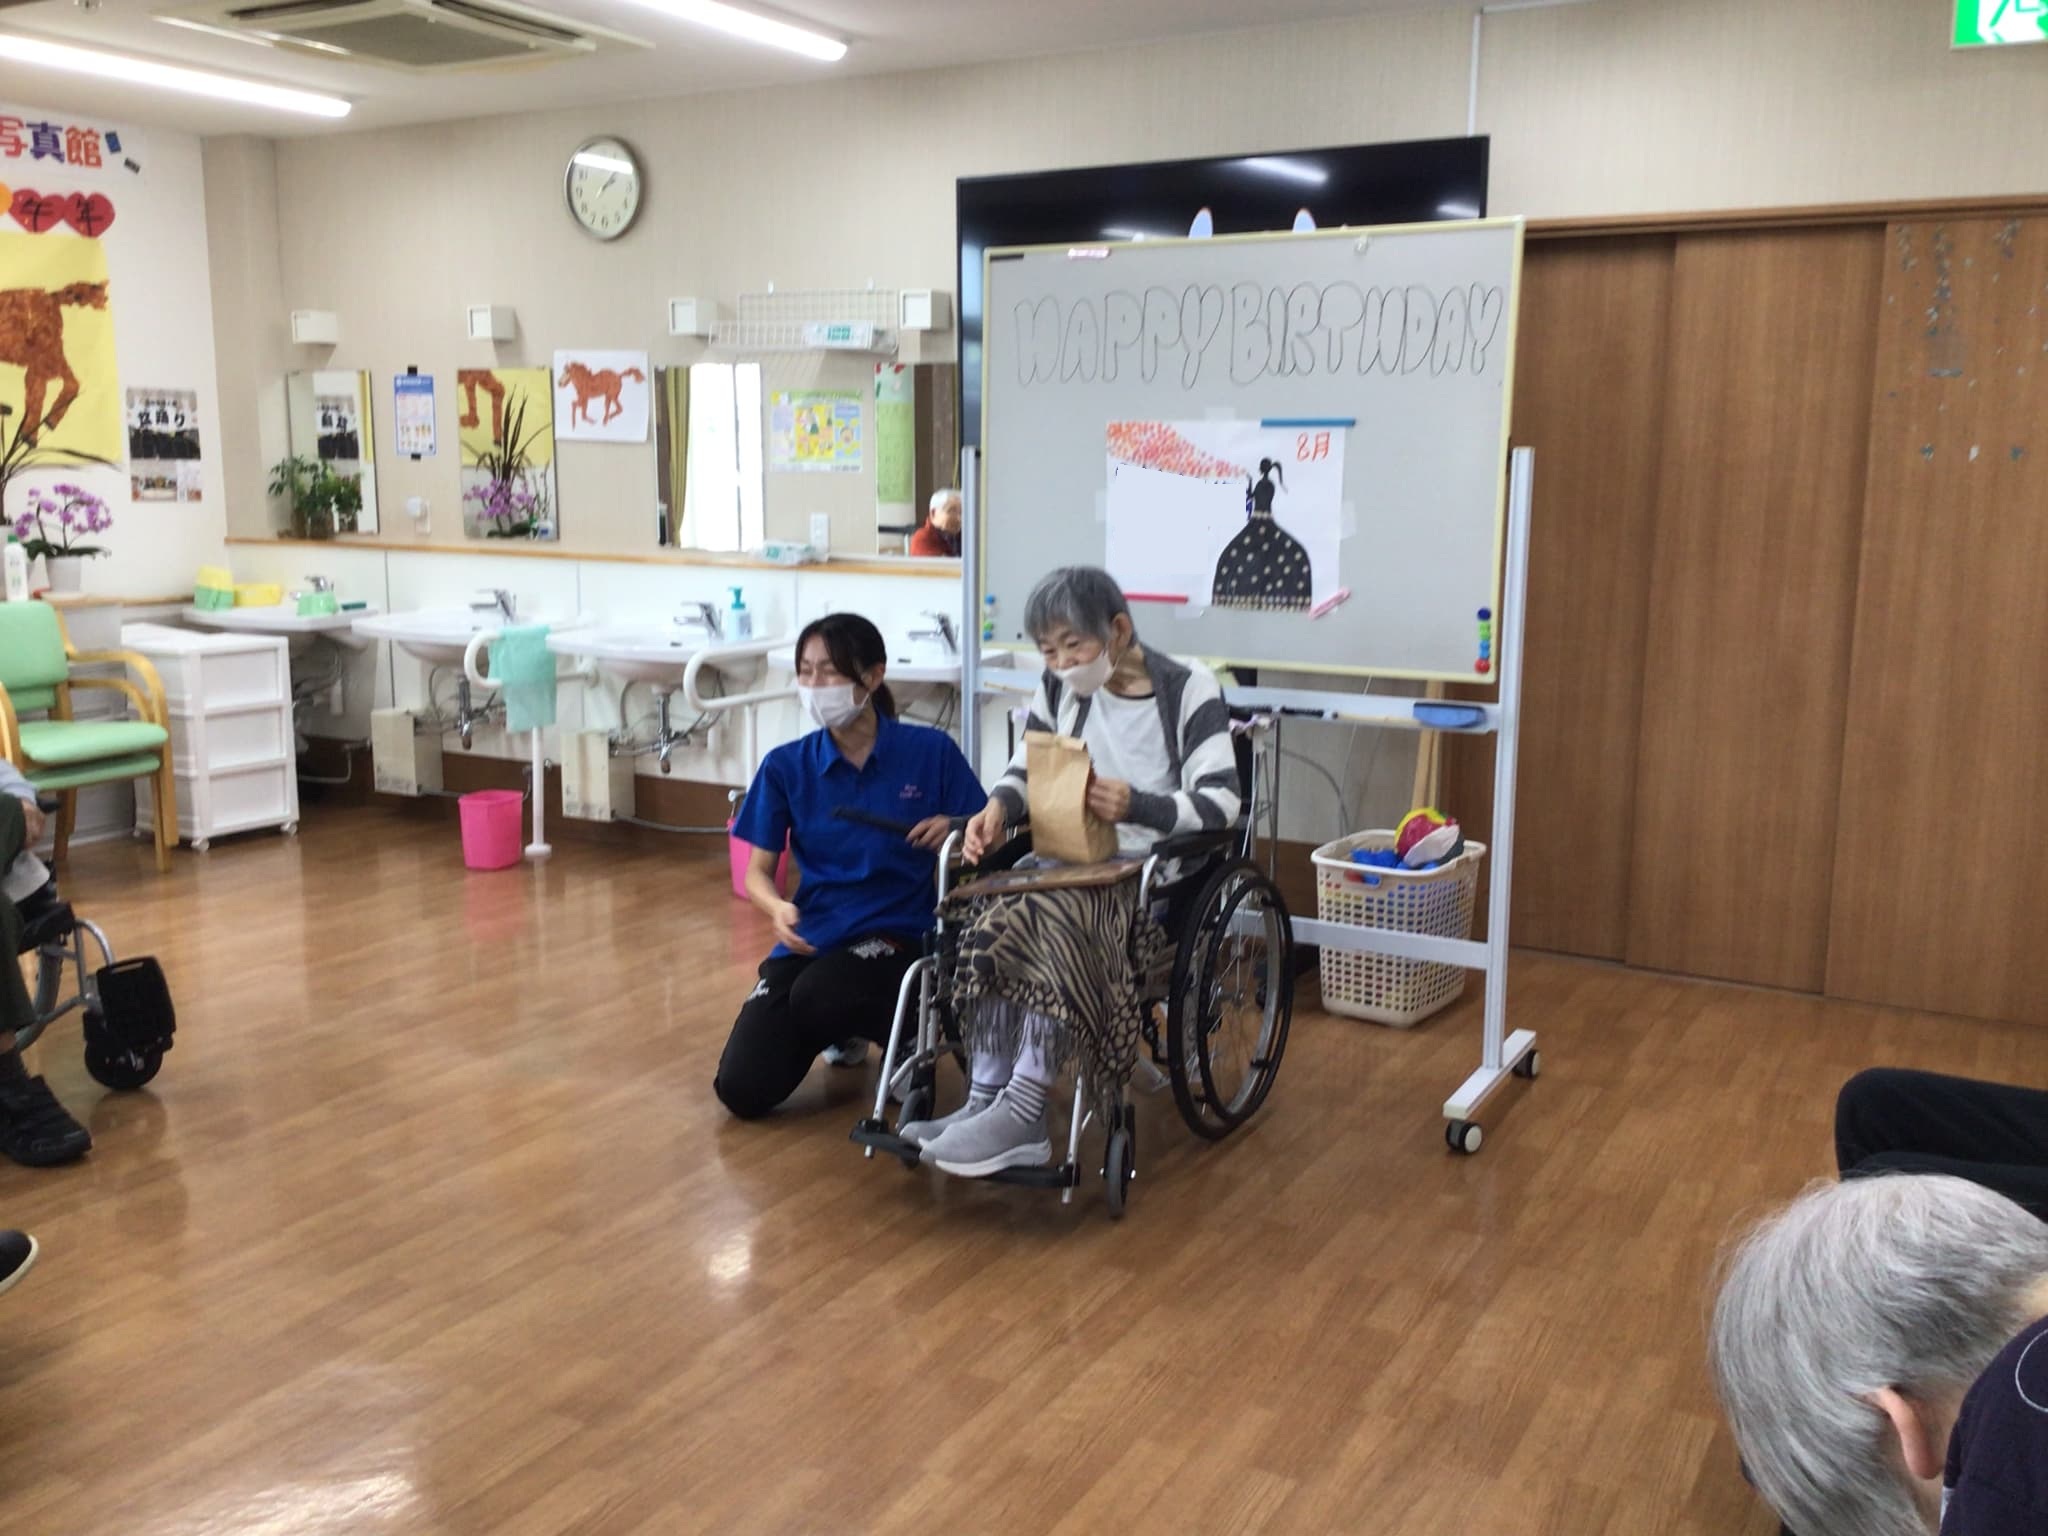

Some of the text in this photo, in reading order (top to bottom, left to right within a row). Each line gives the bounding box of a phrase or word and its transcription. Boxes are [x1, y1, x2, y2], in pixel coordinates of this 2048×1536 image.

[1014, 281, 1503, 390] HAPPY BIRTHDAY
[1297, 432, 1330, 461] 8月
